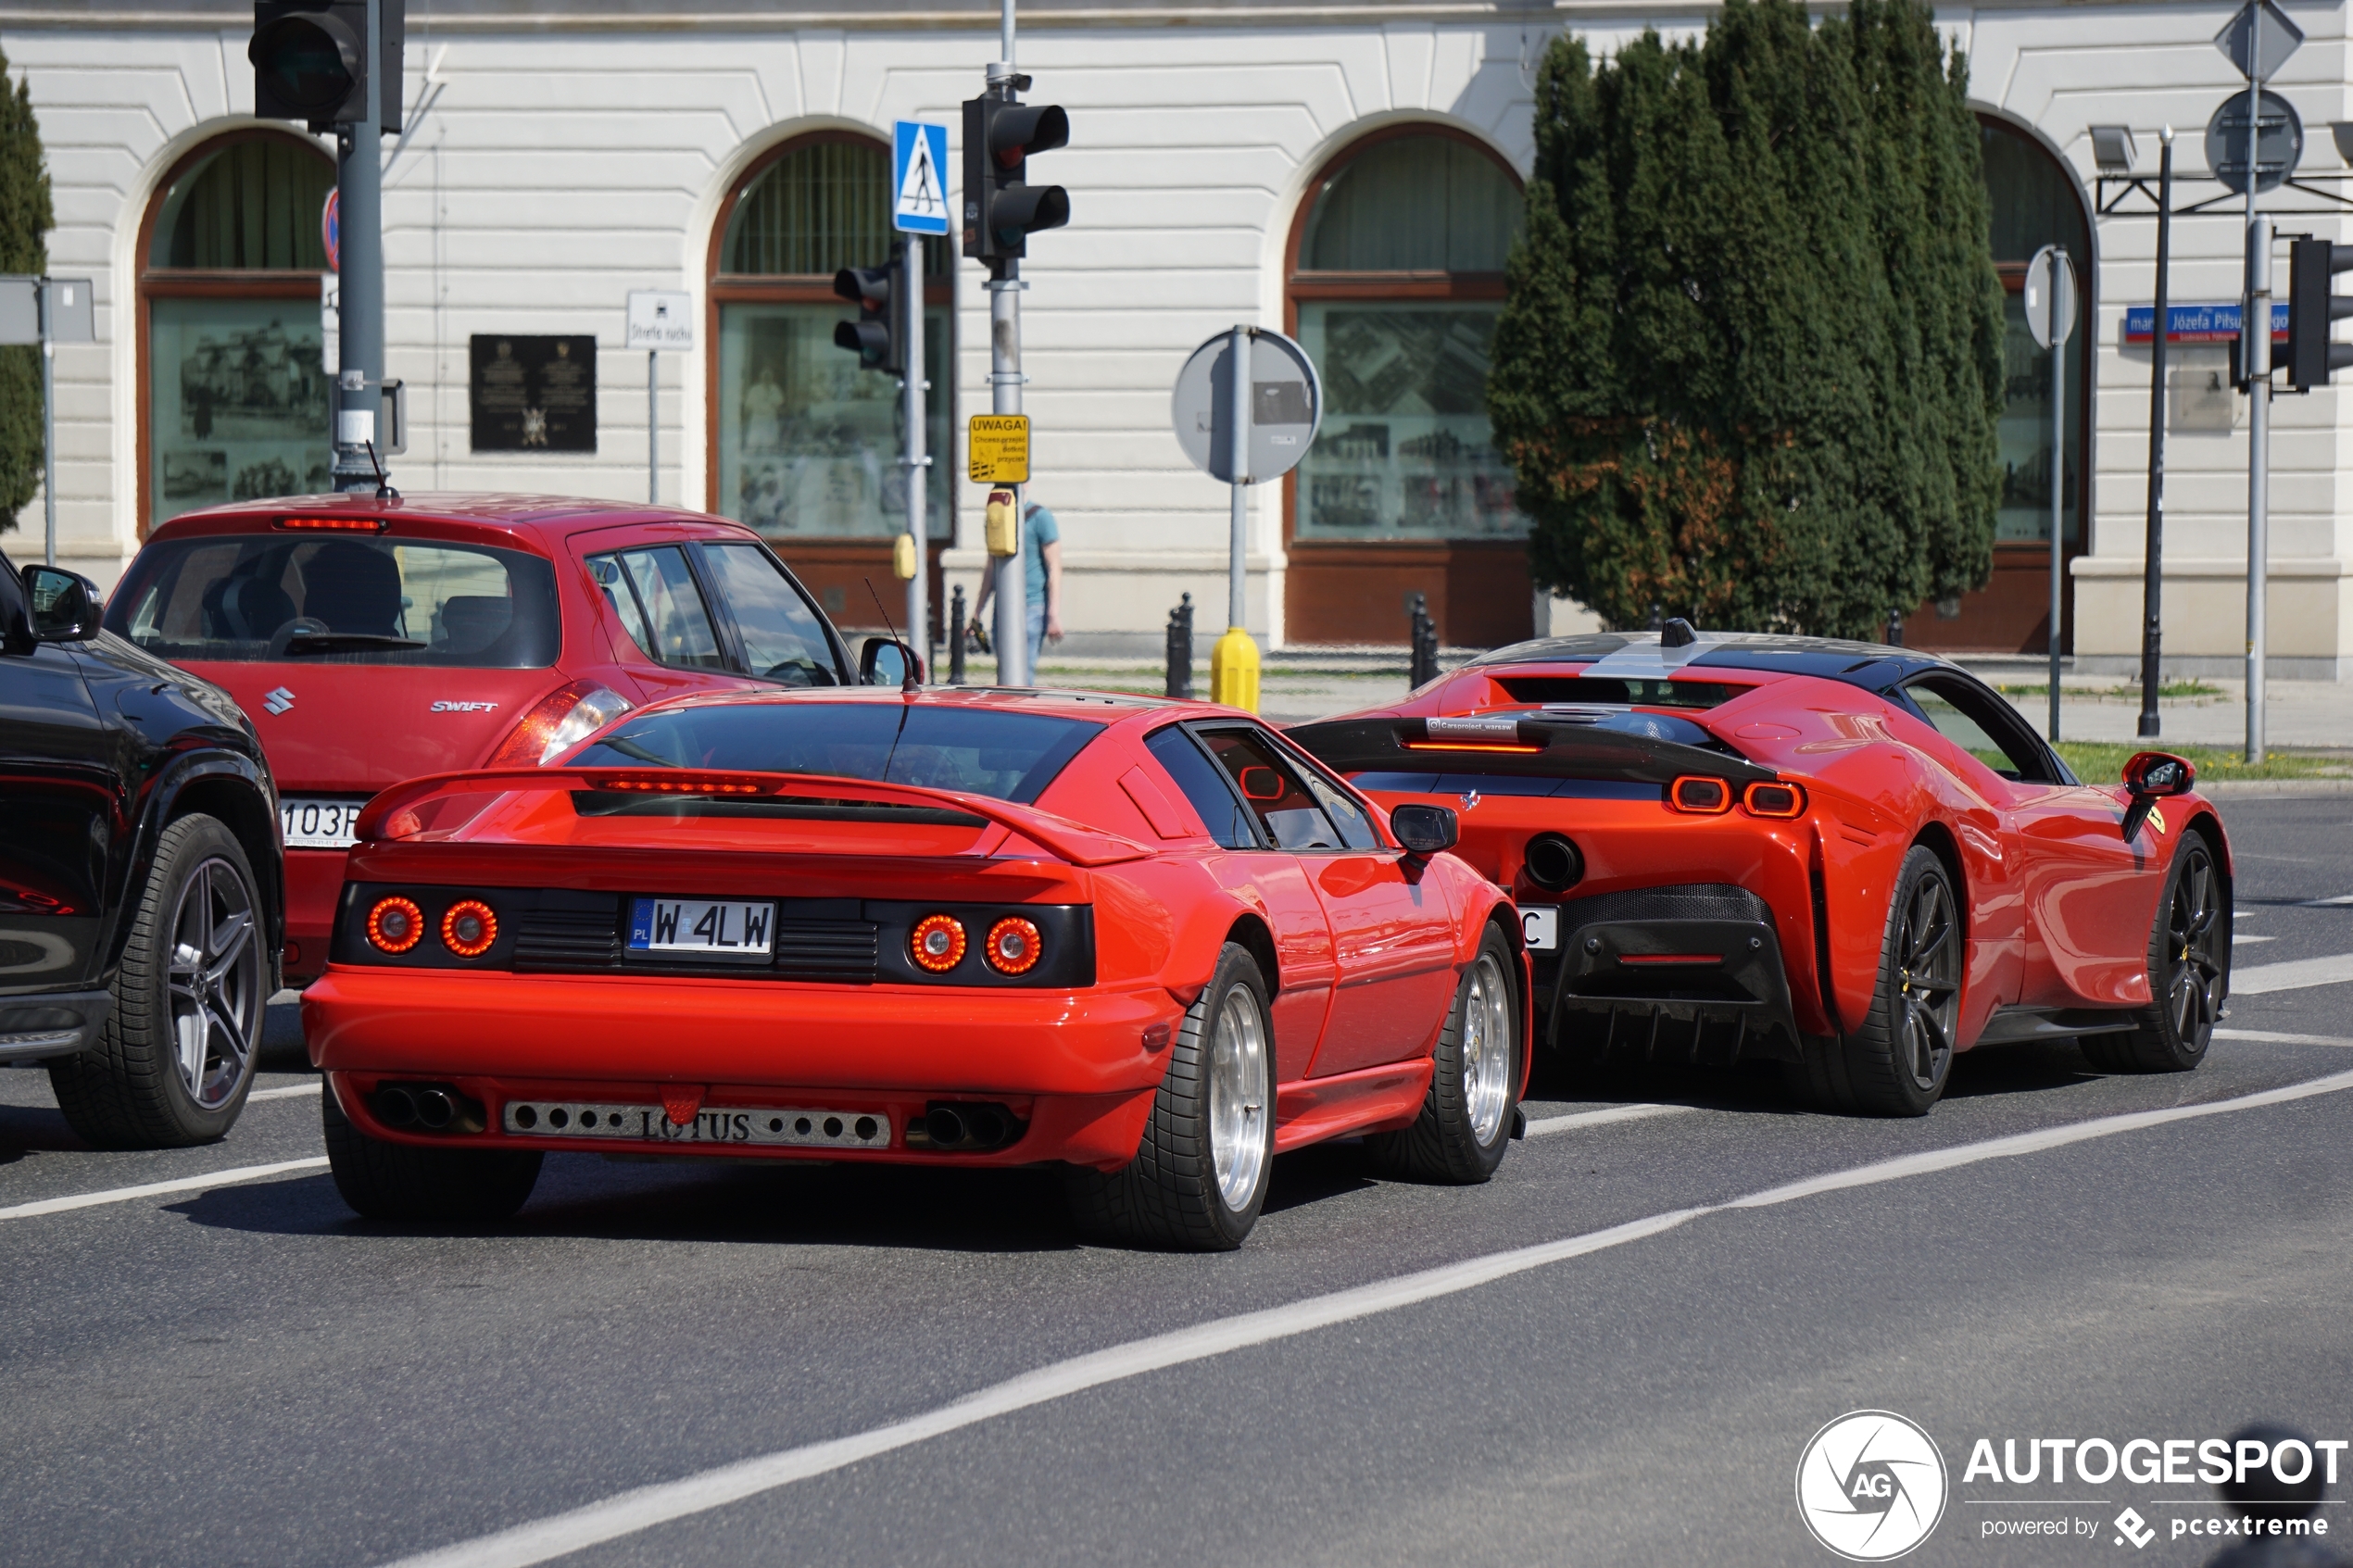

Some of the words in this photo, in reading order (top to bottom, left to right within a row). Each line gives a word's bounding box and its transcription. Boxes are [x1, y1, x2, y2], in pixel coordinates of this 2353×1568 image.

[2172, 311, 2210, 330] Józefa
[973, 420, 1026, 431] UWAGA!
[430, 701, 498, 712] SWIFT
[1441, 721, 1512, 731] Carsproject_warsaw
[634, 929, 648, 940] PL
[655, 903, 682, 945] W
[693, 905, 770, 947] 4LW
[641, 1111, 749, 1140] LOTUS
